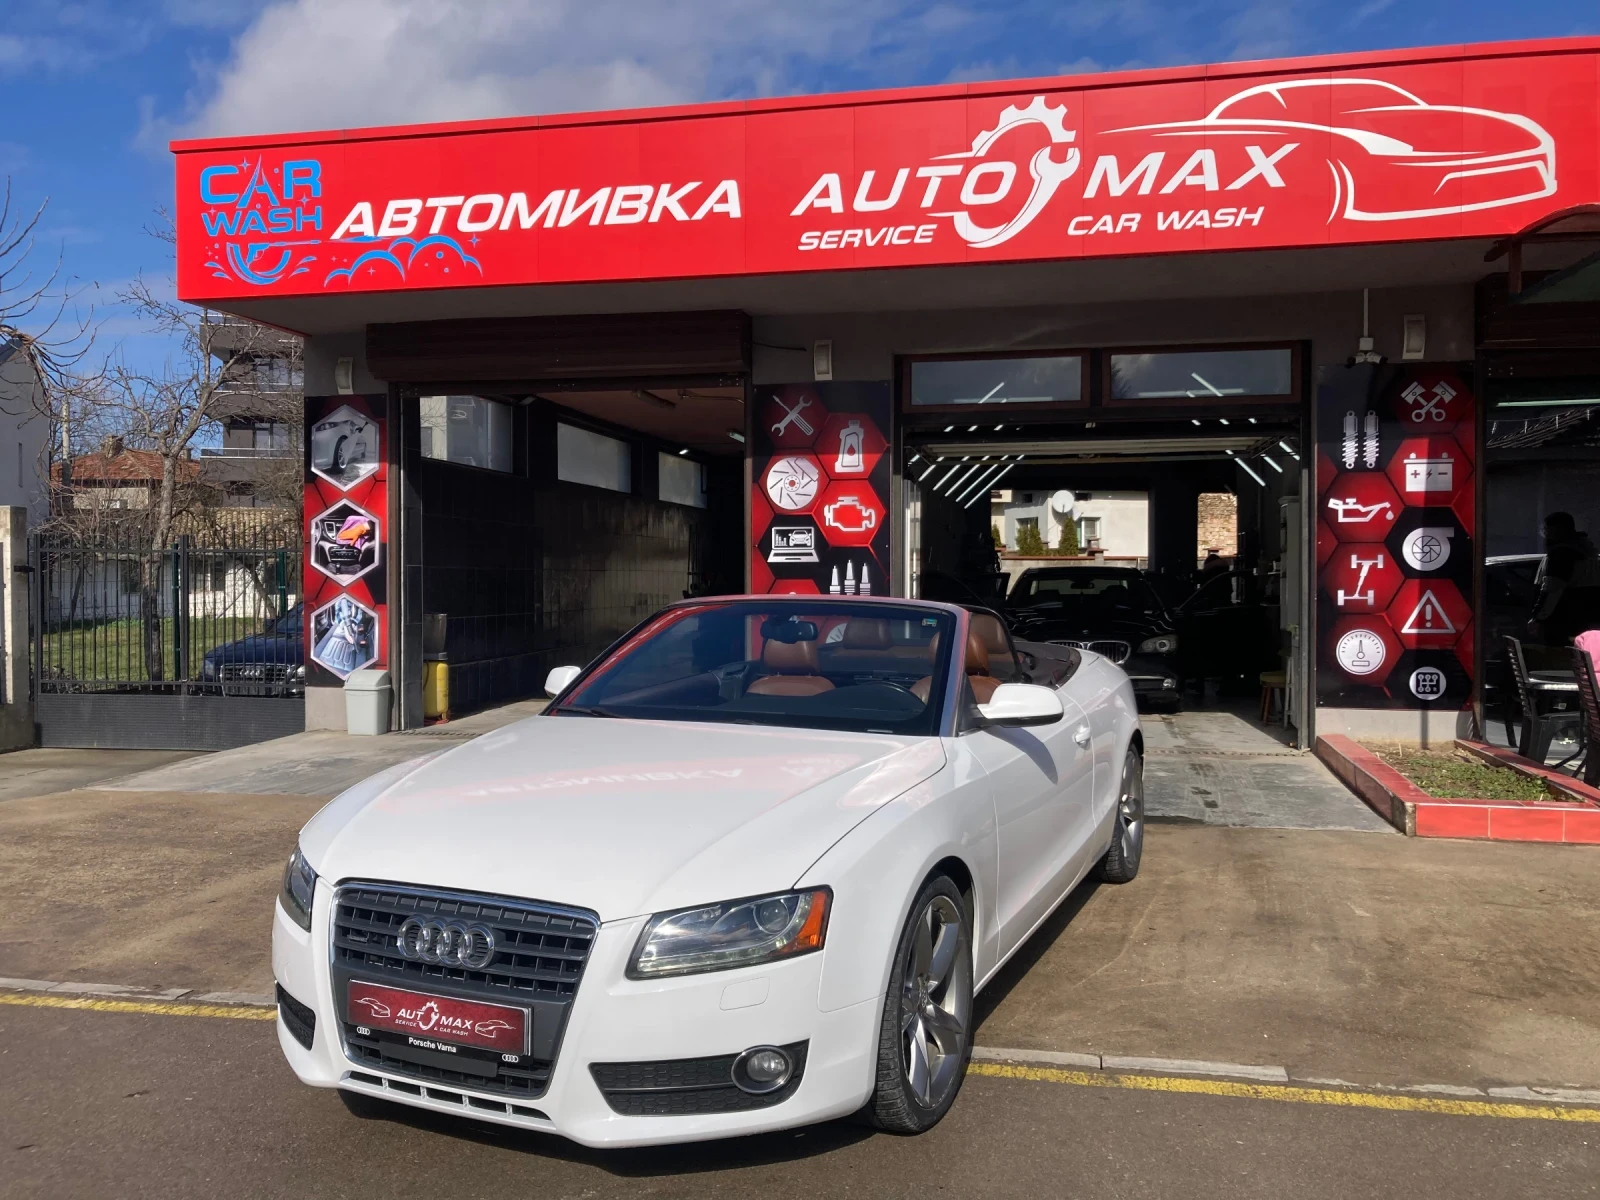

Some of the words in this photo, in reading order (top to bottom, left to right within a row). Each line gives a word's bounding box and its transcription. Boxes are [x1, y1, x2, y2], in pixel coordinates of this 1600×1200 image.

[200, 154, 322, 208] CAR
[789, 160, 1018, 216] AUTO
[1082, 142, 1301, 199] MAX
[202, 206, 322, 236] WASH
[329, 179, 742, 240] АВТОМИВКА
[797, 223, 938, 251] SERVICE
[1067, 212, 1142, 236] CAR
[1156, 206, 1265, 231] WASH
[408, 1036, 436, 1049] Porsche
[436, 1042, 457, 1053] Varna
